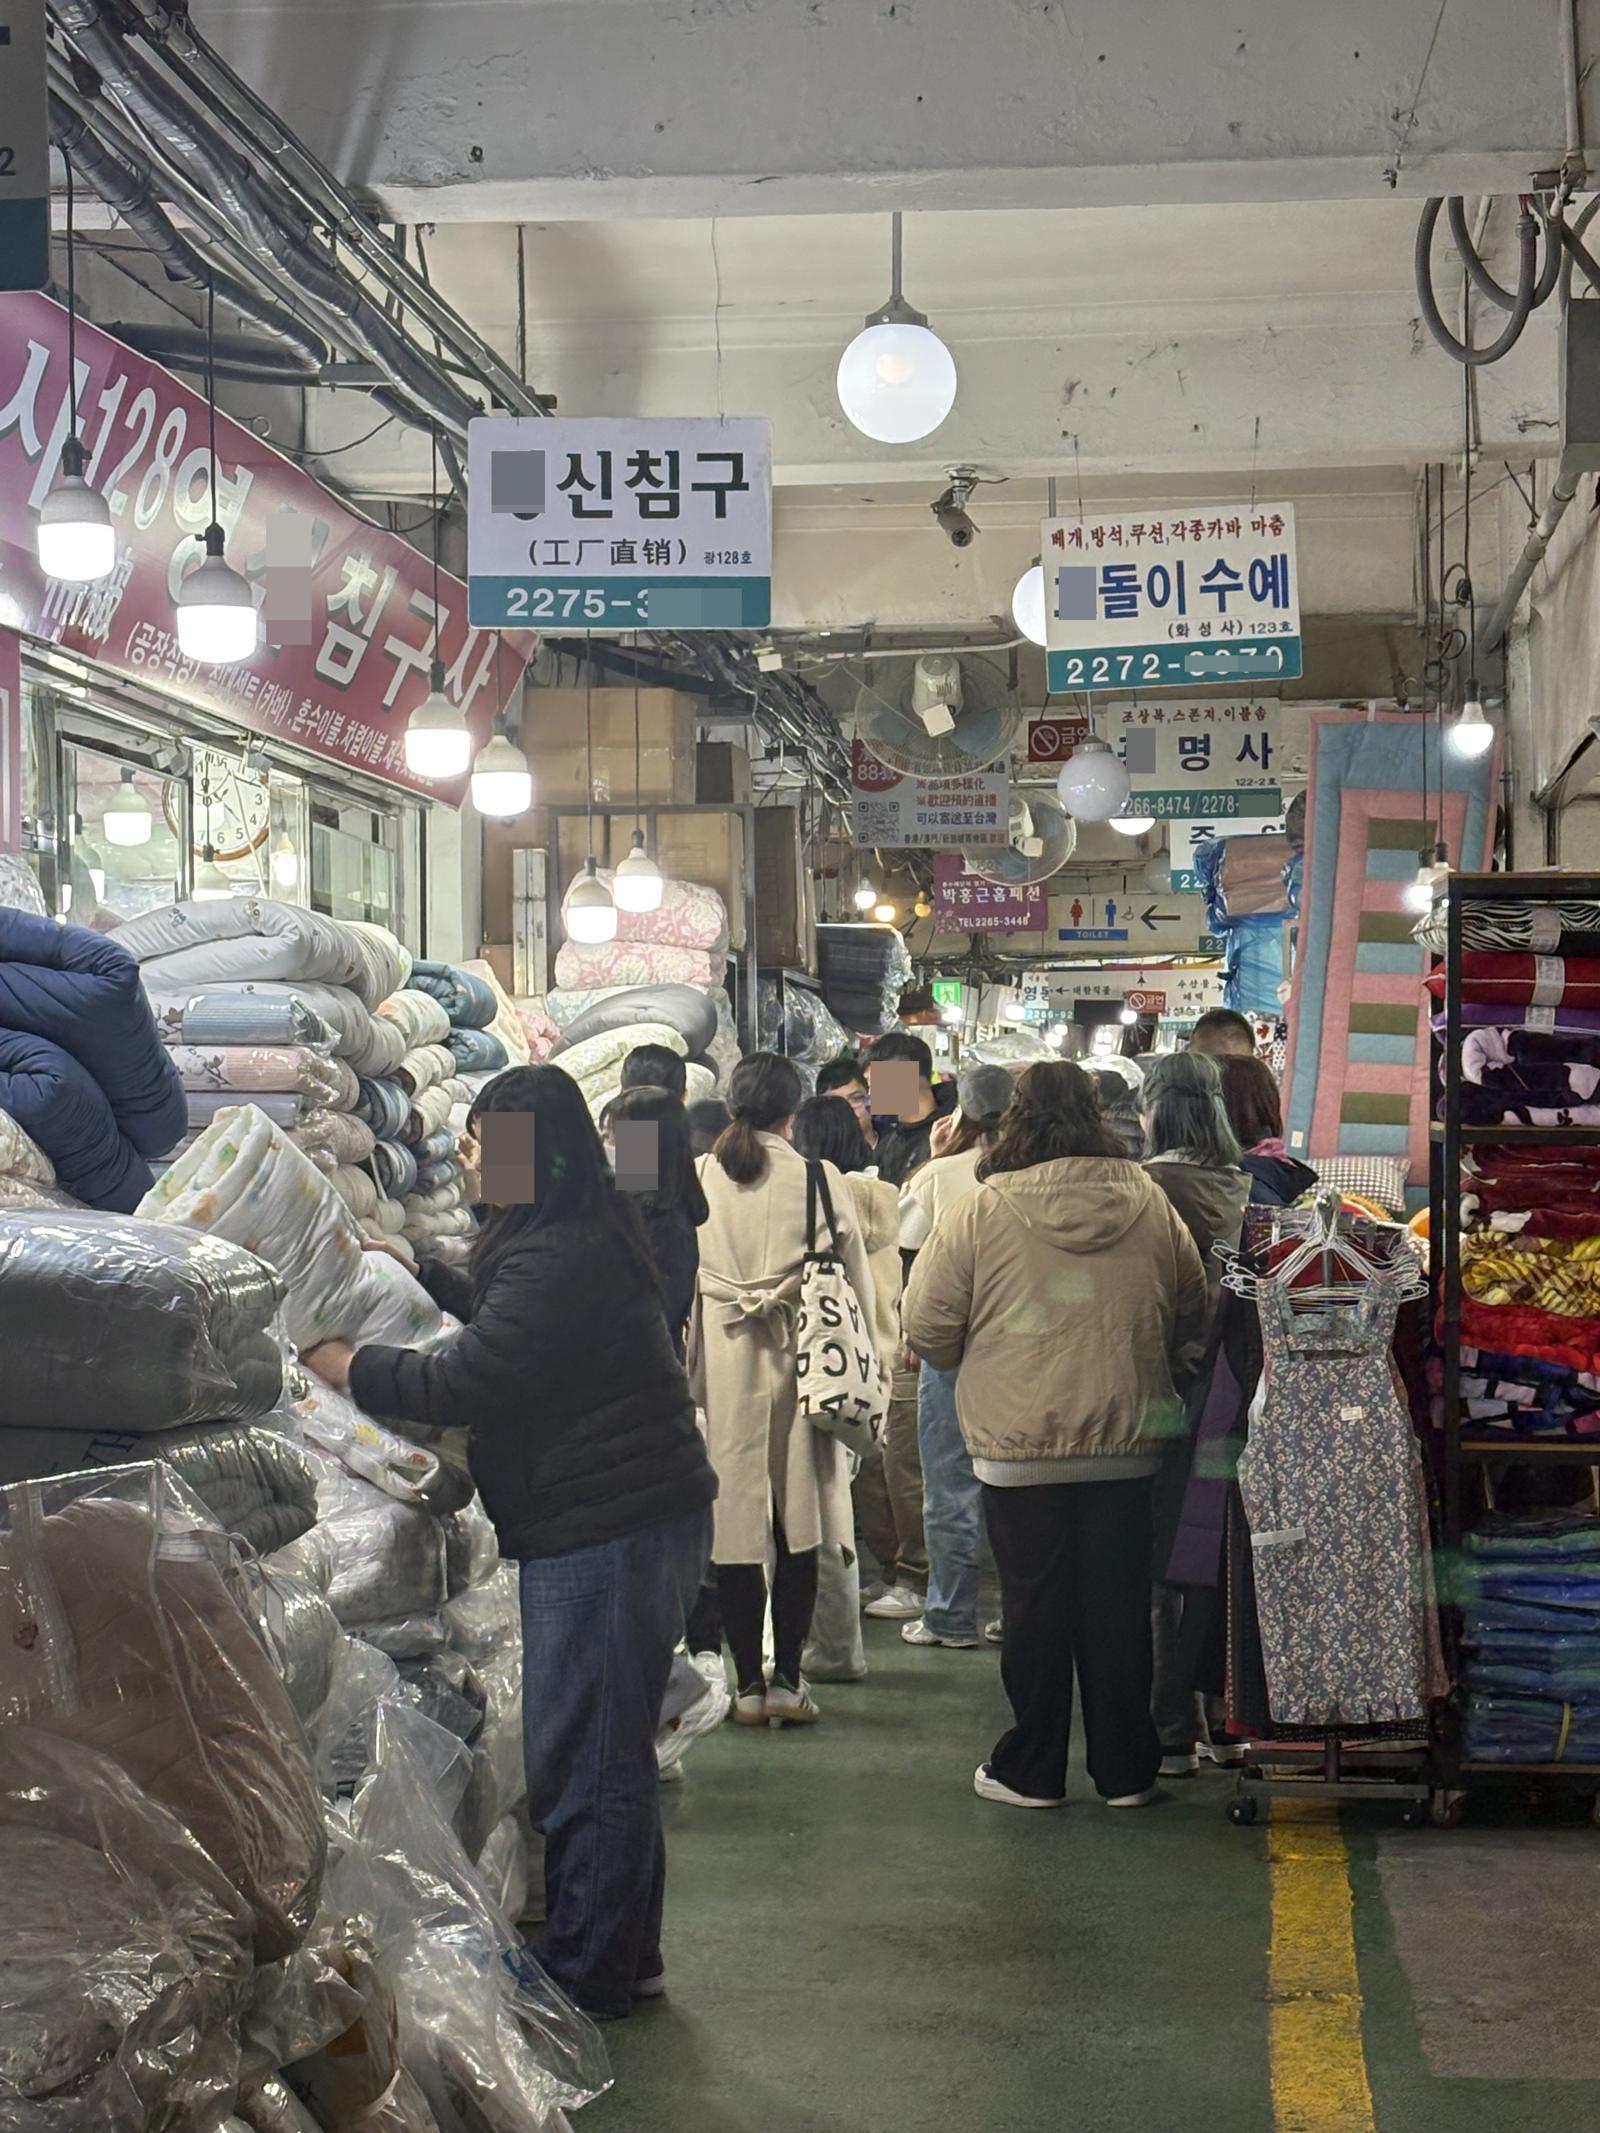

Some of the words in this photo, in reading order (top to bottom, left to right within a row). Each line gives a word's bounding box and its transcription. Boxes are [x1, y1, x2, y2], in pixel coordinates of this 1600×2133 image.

[493, 450, 750, 520] 신침구
[529, 538, 687, 566] (工厂直销)
[1054, 560, 1187, 621] 돌이
[1118, 731, 1273, 772] 명사
[1077, 931, 1109, 939] TOILET
